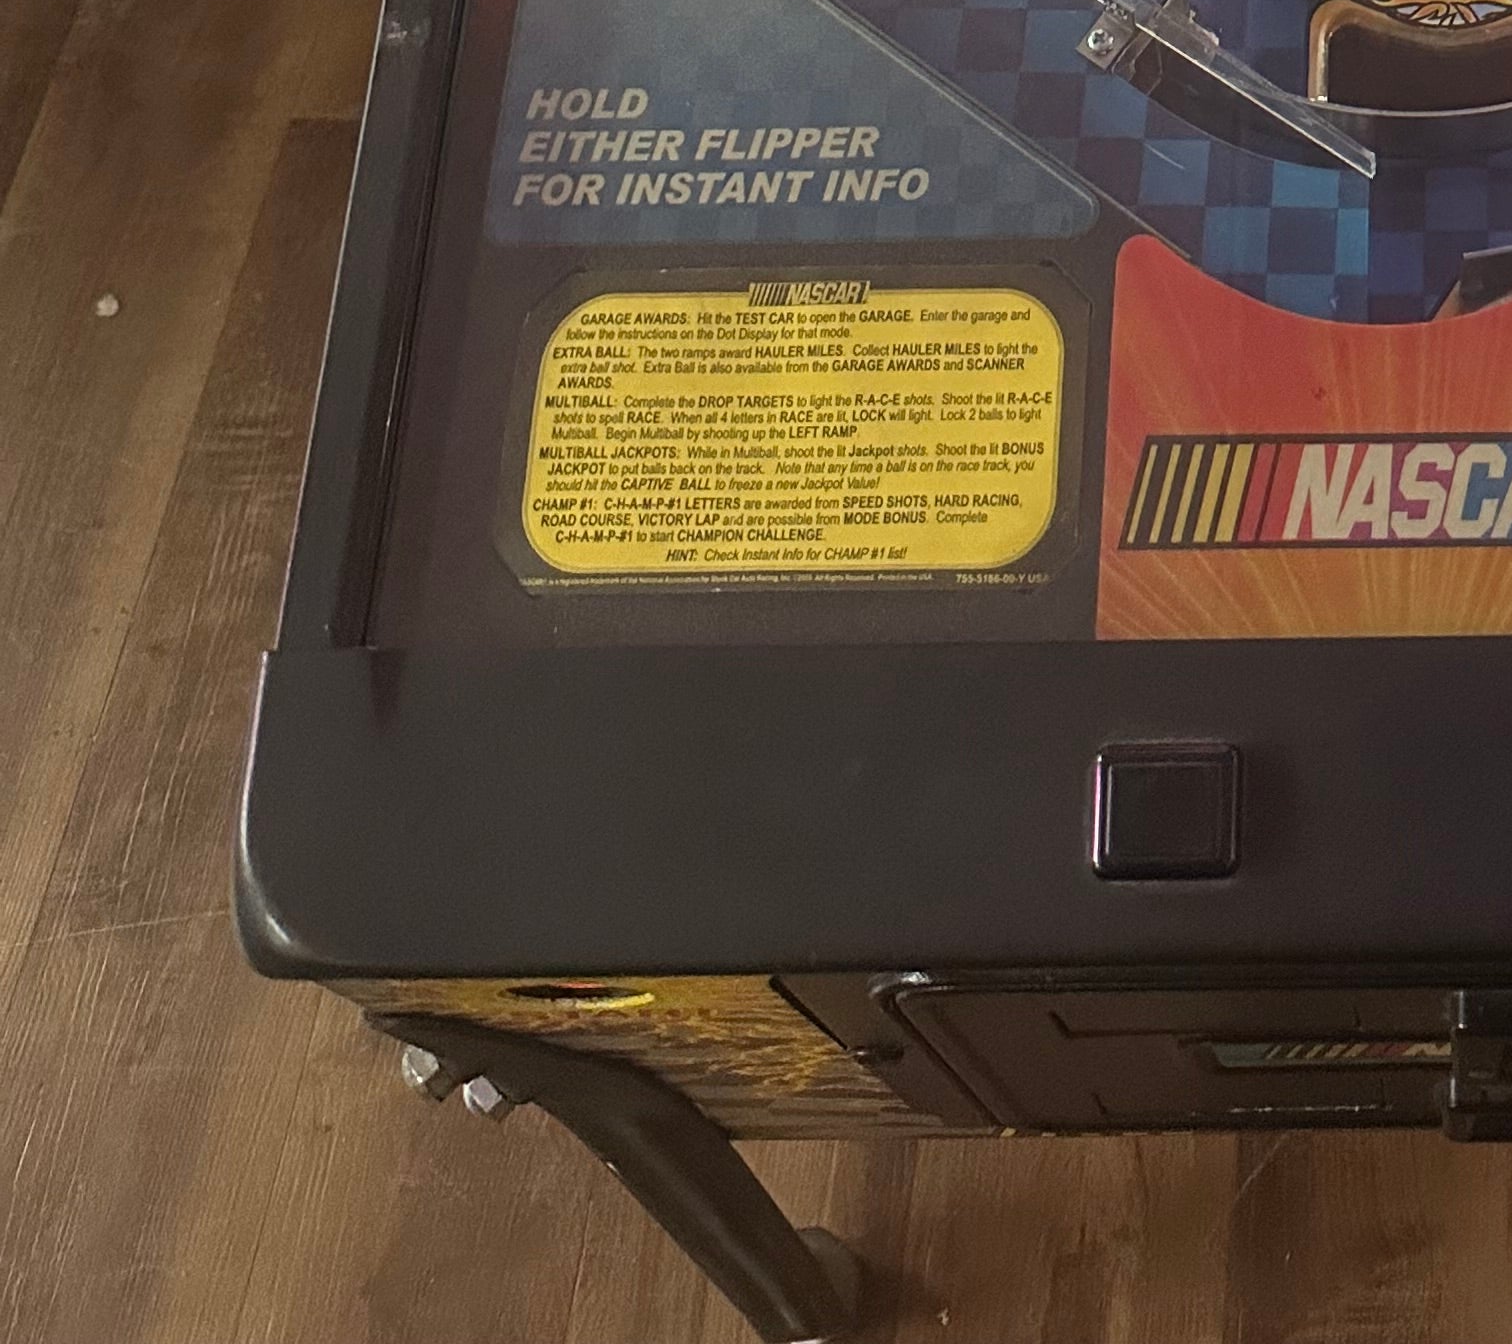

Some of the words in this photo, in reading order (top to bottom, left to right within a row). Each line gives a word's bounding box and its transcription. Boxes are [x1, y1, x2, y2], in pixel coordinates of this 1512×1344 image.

[526, 87, 649, 120] HOLD
[519, 129, 685, 163] EITHER
[694, 126, 880, 161] FLIPPER
[512, 173, 606, 206] FOR
[615, 170, 815, 205] INSTANT
[822, 167, 930, 202] INFO
[786, 283, 865, 305] NASCAR
[580, 313, 632, 324] GARAGE
[634, 312, 691, 324] AWARDS:
[553, 346, 592, 358] EXTRA
[595, 346, 631, 358] BALL:
[545, 396, 616, 408] MULTIBALL:
[539, 446, 609, 458] MULTIBALL
[610, 446, 681, 458] JACKPOTS:
[533, 498, 577, 510] CHAMP
[580, 498, 597, 509] #1:
[666, 550, 698, 561] HINT:
[704, 549, 740, 561] Check
[742, 549, 780, 560] Instant
